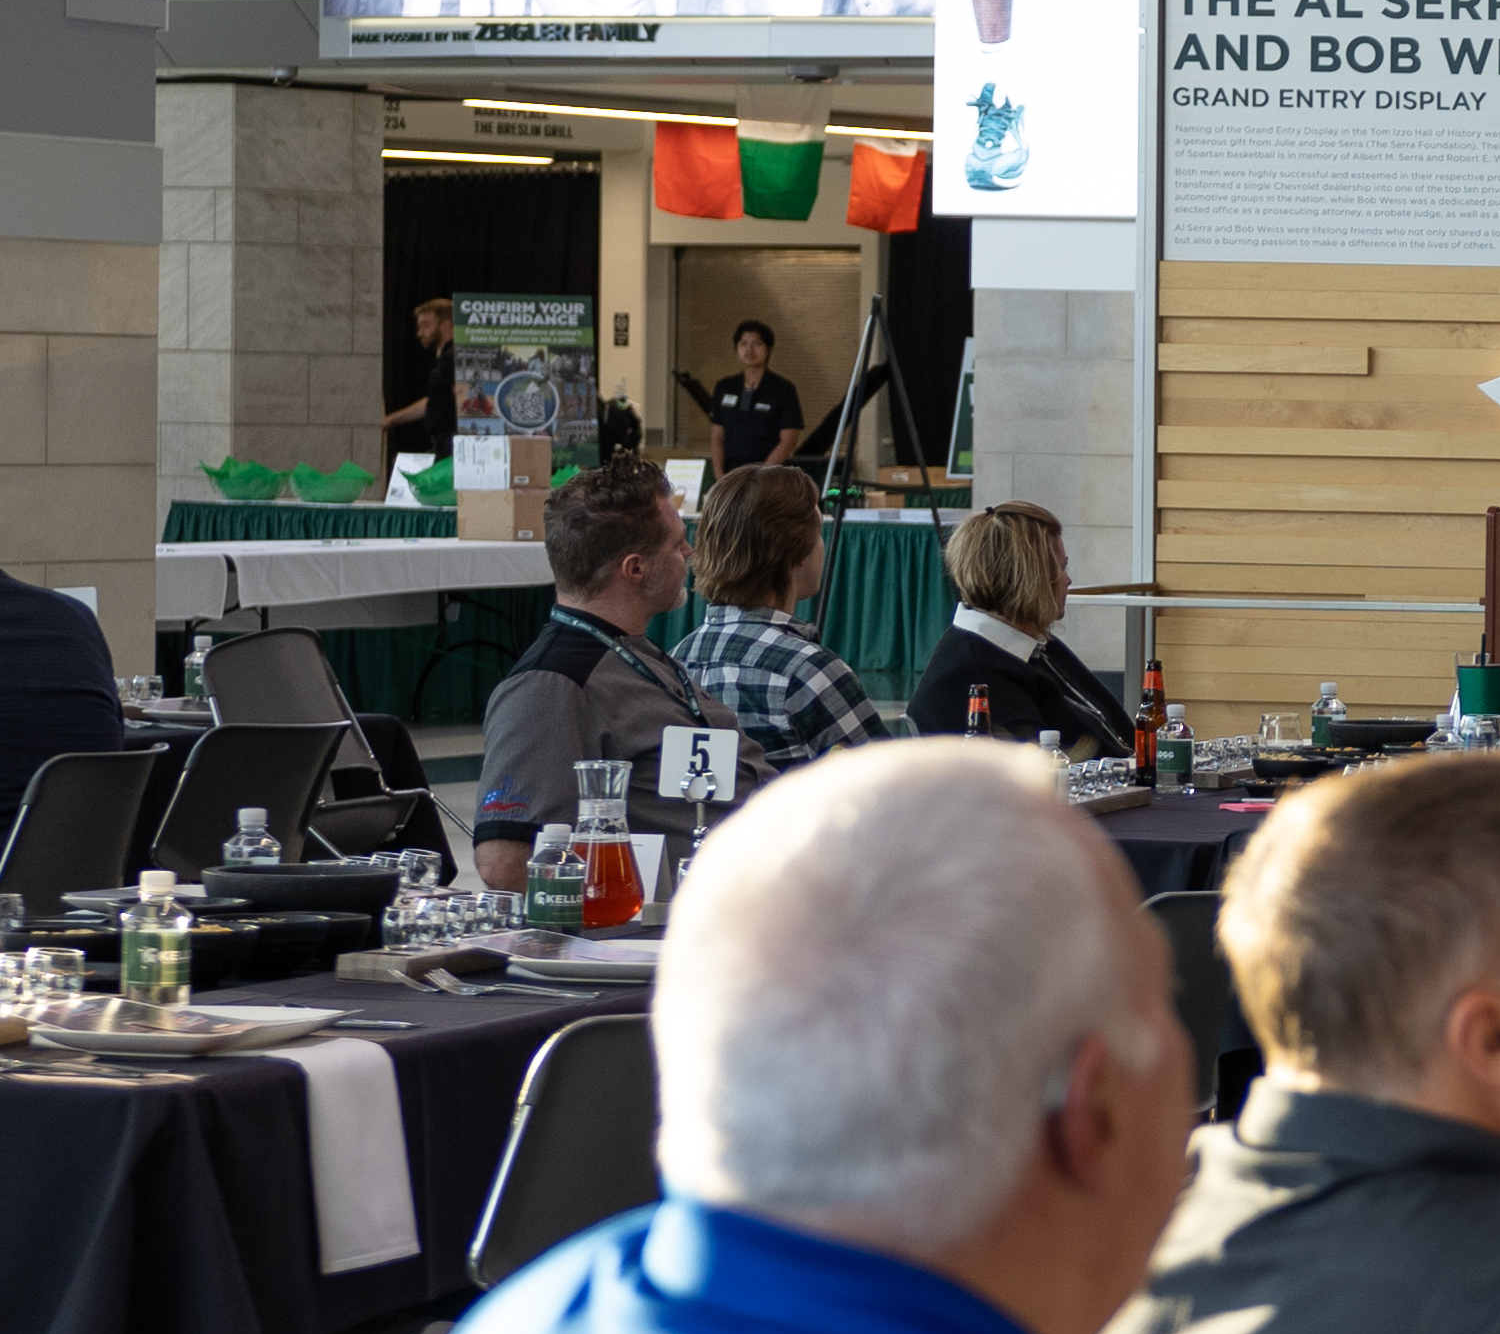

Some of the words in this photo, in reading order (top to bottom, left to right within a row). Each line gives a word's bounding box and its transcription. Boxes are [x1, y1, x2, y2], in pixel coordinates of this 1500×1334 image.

[474, 22, 571, 42] ZEIGLER
[575, 23, 661, 42] FAMILY
[1173, 33, 1290, 71] AND
[1310, 35, 1422, 74] BOB
[1172, 86, 1270, 108] GRAND
[1279, 88, 1367, 109] ENTRY
[1375, 90, 1487, 111] DISPLAY
[474, 120, 493, 134] THE
[497, 122, 542, 136] BRESLIN
[544, 124, 573, 138] GRILL
[1175, 124, 1212, 135] Naming
[1214, 125, 1224, 133] of
[1226, 125, 1242, 134] the
[1244, 125, 1274, 134] Grand
[1276, 126, 1301, 137] Entry
[1304, 126, 1339, 138] Display
[1341, 127, 1350, 135] in
[1352, 127, 1368, 136] the
[1371, 127, 1391, 136] Tom
[1393, 128, 1412, 137] Izzo
[1415, 128, 1433, 137] Hall
[1435, 128, 1445, 137] of
[1447, 128, 1482, 140] History
[1183, 138, 1227, 148] generous
[1229, 137, 1246, 148] gift
[1249, 137, 1271, 146] from
[1274, 138, 1296, 147] Julie
[1298, 138, 1316, 147] and
[1319, 139, 1336, 147] Joe
[1338, 139, 1363, 148] Serra
[1365, 139, 1388, 151] (The
[1390, 140, 1416, 149] Serra
[1418, 140, 1478, 152] Foundation).
[1175, 149, 1185, 157] of
[1187, 149, 1225, 160] Spartan
[1227, 150, 1275, 159] basketball
[1277, 150, 1285, 159] is
[1287, 151, 1296, 159] in
[1298, 153, 1338, 162] memory
[1340, 151, 1350, 160] of
[1352, 152, 1382, 161] Albert
[1385, 152, 1396, 161] M.
[1398, 152, 1424, 161] Serra
[1426, 153, 1444, 162] and
[1446, 153, 1479, 162] Robert
[1482, 154, 1492, 163] E.
[1175, 167, 1198, 176] Both
[1248, 168, 1277, 180] highly
[1280, 169, 1329, 178] successful
[1330, 170, 1349, 179] and
[1351, 170, 1398, 179] esteemed
[1400, 171, 1409, 180] in
[1411, 171, 1433, 180] their
[1435, 171, 1485, 183] respective
[1175, 180, 1233, 189] transformed
[1244, 181, 1271, 192] single
[1273, 181, 1319, 191] Chevrolet
[1322, 182, 1372, 194] dealership
[1374, 183, 1392, 192] into
[1414, 184, 1425, 193] of
[1427, 184, 1443, 193] the
[1445, 184, 1461, 196] top
[1463, 185, 1479, 194] ten
[1174, 192, 1228, 202] automotive
[1230, 195, 1264, 204] groups
[1266, 194, 1275, 202] in
[1277, 194, 1293, 203] the
[1295, 194, 1327, 206] nation,
[1330, 195, 1355, 204] while
[1357, 195, 1377, 204] Bob
[1379, 196, 1407, 205] Weiss
[1438, 197, 1486, 206] dedicated
[1174, 204, 1210, 214] elected
[1212, 205, 1239, 214] office
[1262, 206, 1319, 218] prosecuting
[1321, 207, 1364, 219] attorney,
[1374, 208, 1412, 219] probate
[1414, 209, 1443, 220] judge,
[1459, 209, 1478, 218] well
[460, 300, 536, 315] CONFIRM
[540, 302, 586, 316] YOUR
[467, 313, 579, 326] ATTENDANCE
[689, 732, 711, 773] 5
